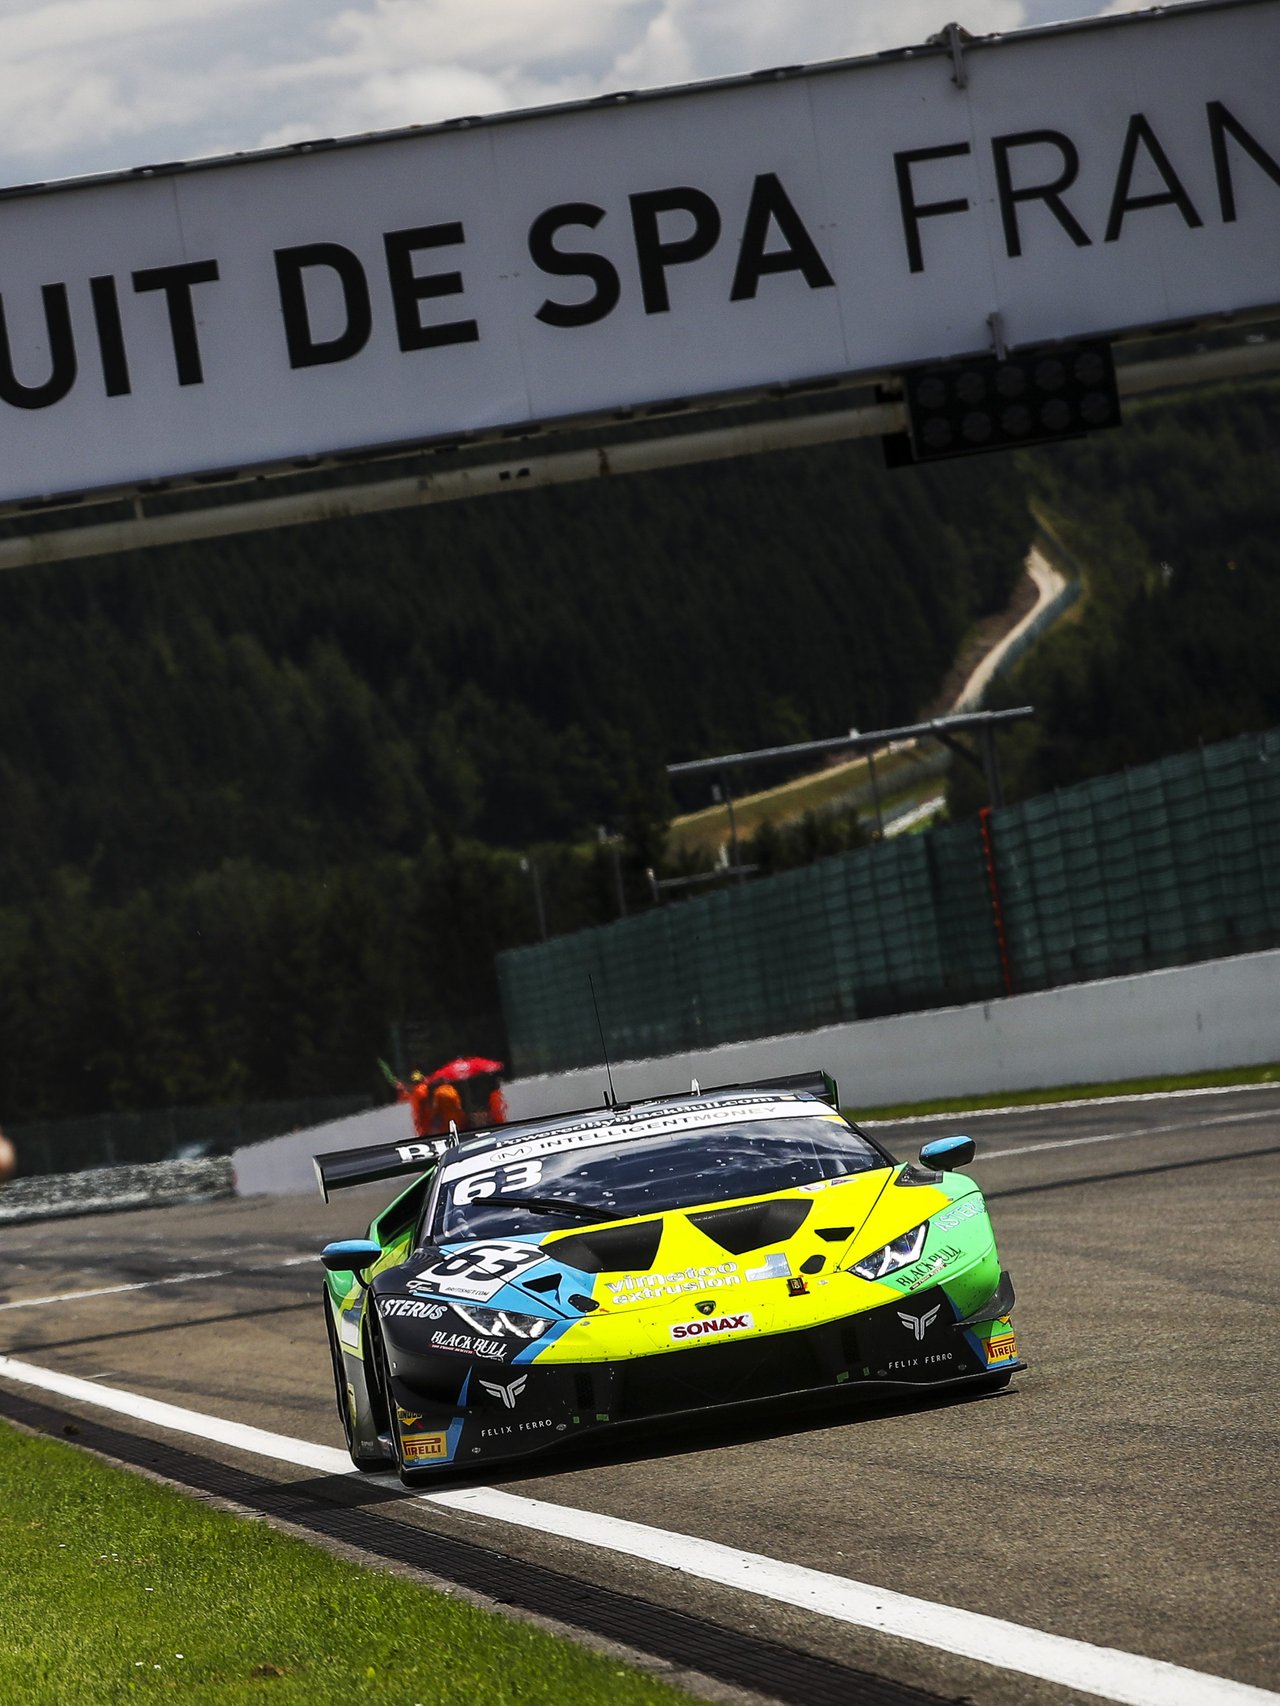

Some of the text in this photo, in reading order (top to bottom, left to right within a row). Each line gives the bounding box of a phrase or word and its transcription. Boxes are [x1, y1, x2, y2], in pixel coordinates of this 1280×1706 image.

[274, 221, 479, 370] DE
[528, 172, 835, 327] SPA
[453, 1160, 543, 1206] 63
[431, 1245, 546, 1282] 63
[896, 1261, 935, 1287] BLACK
[611, 1273, 742, 1305] extrusion
[672, 1315, 748, 1339] SONAX
[430, 1330, 475, 1350] BLACK
[472, 1338, 508, 1360] BULL
[888, 1353, 953, 1369] FELIX FERRO
[481, 1419, 553, 1438] FELIX FERRO
[403, 1437, 442, 1456] PIRELLI
